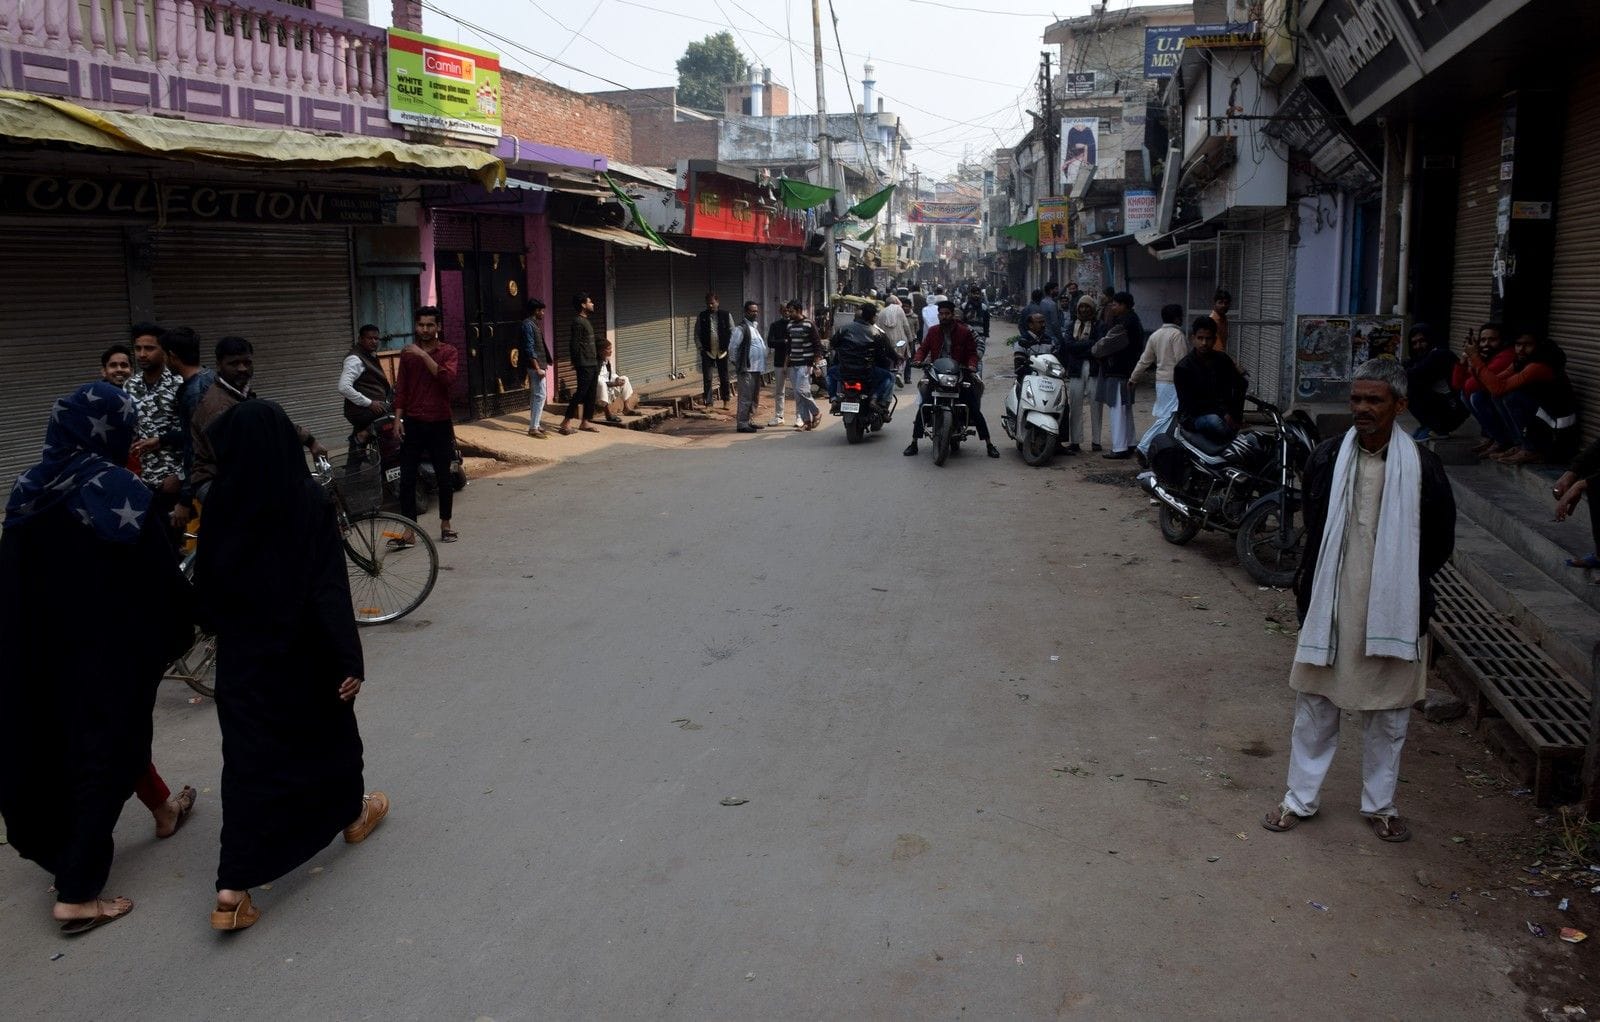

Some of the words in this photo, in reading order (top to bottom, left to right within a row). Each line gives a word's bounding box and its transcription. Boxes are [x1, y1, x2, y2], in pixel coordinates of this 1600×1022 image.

[426, 56, 462, 75] Camlin
[397, 75, 423, 87] WHITE
[397, 84, 423, 96] GLUE
[26, 175, 327, 221] COLLECTION
